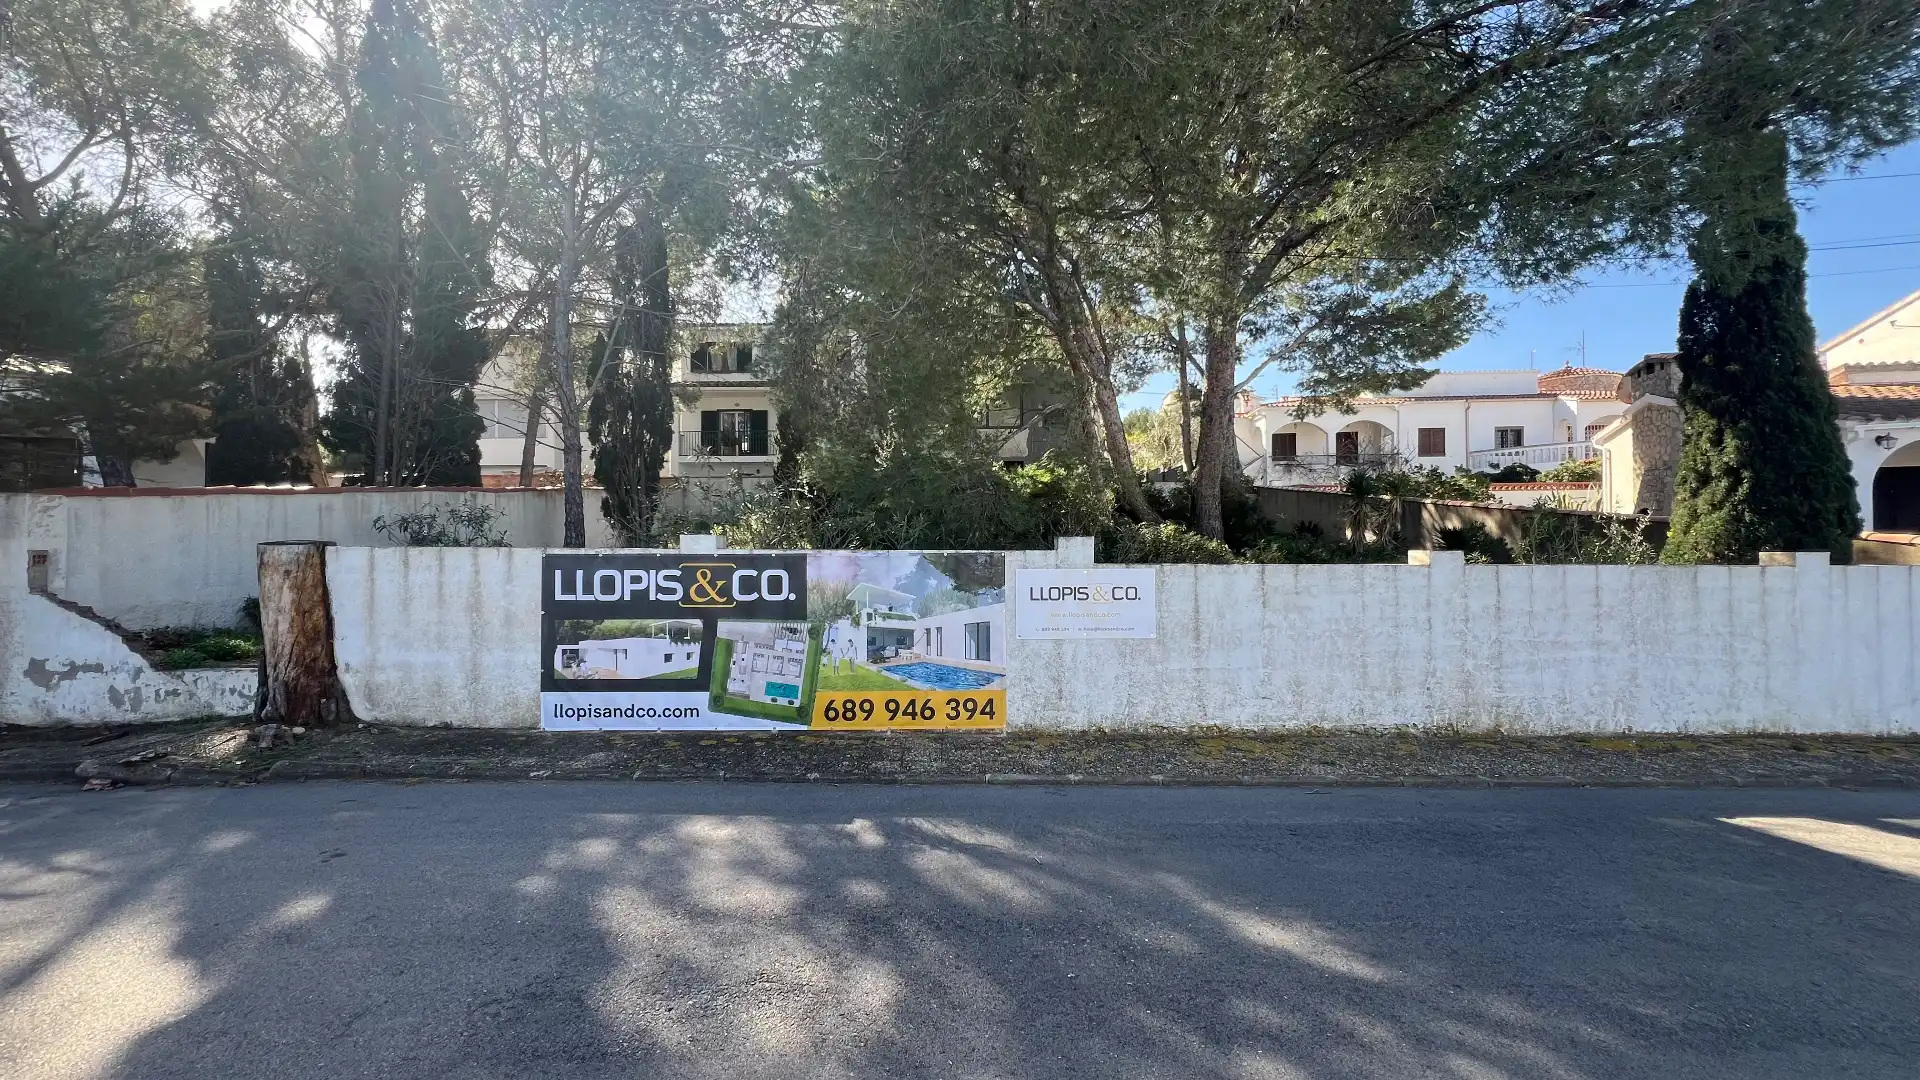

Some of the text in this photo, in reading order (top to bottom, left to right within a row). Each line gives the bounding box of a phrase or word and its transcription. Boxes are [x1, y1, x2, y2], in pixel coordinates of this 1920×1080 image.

[554, 569, 684, 601] LLOPIS
[554, 703, 700, 721] llopisandco.com
[823, 697, 996, 722] 689 946 394
